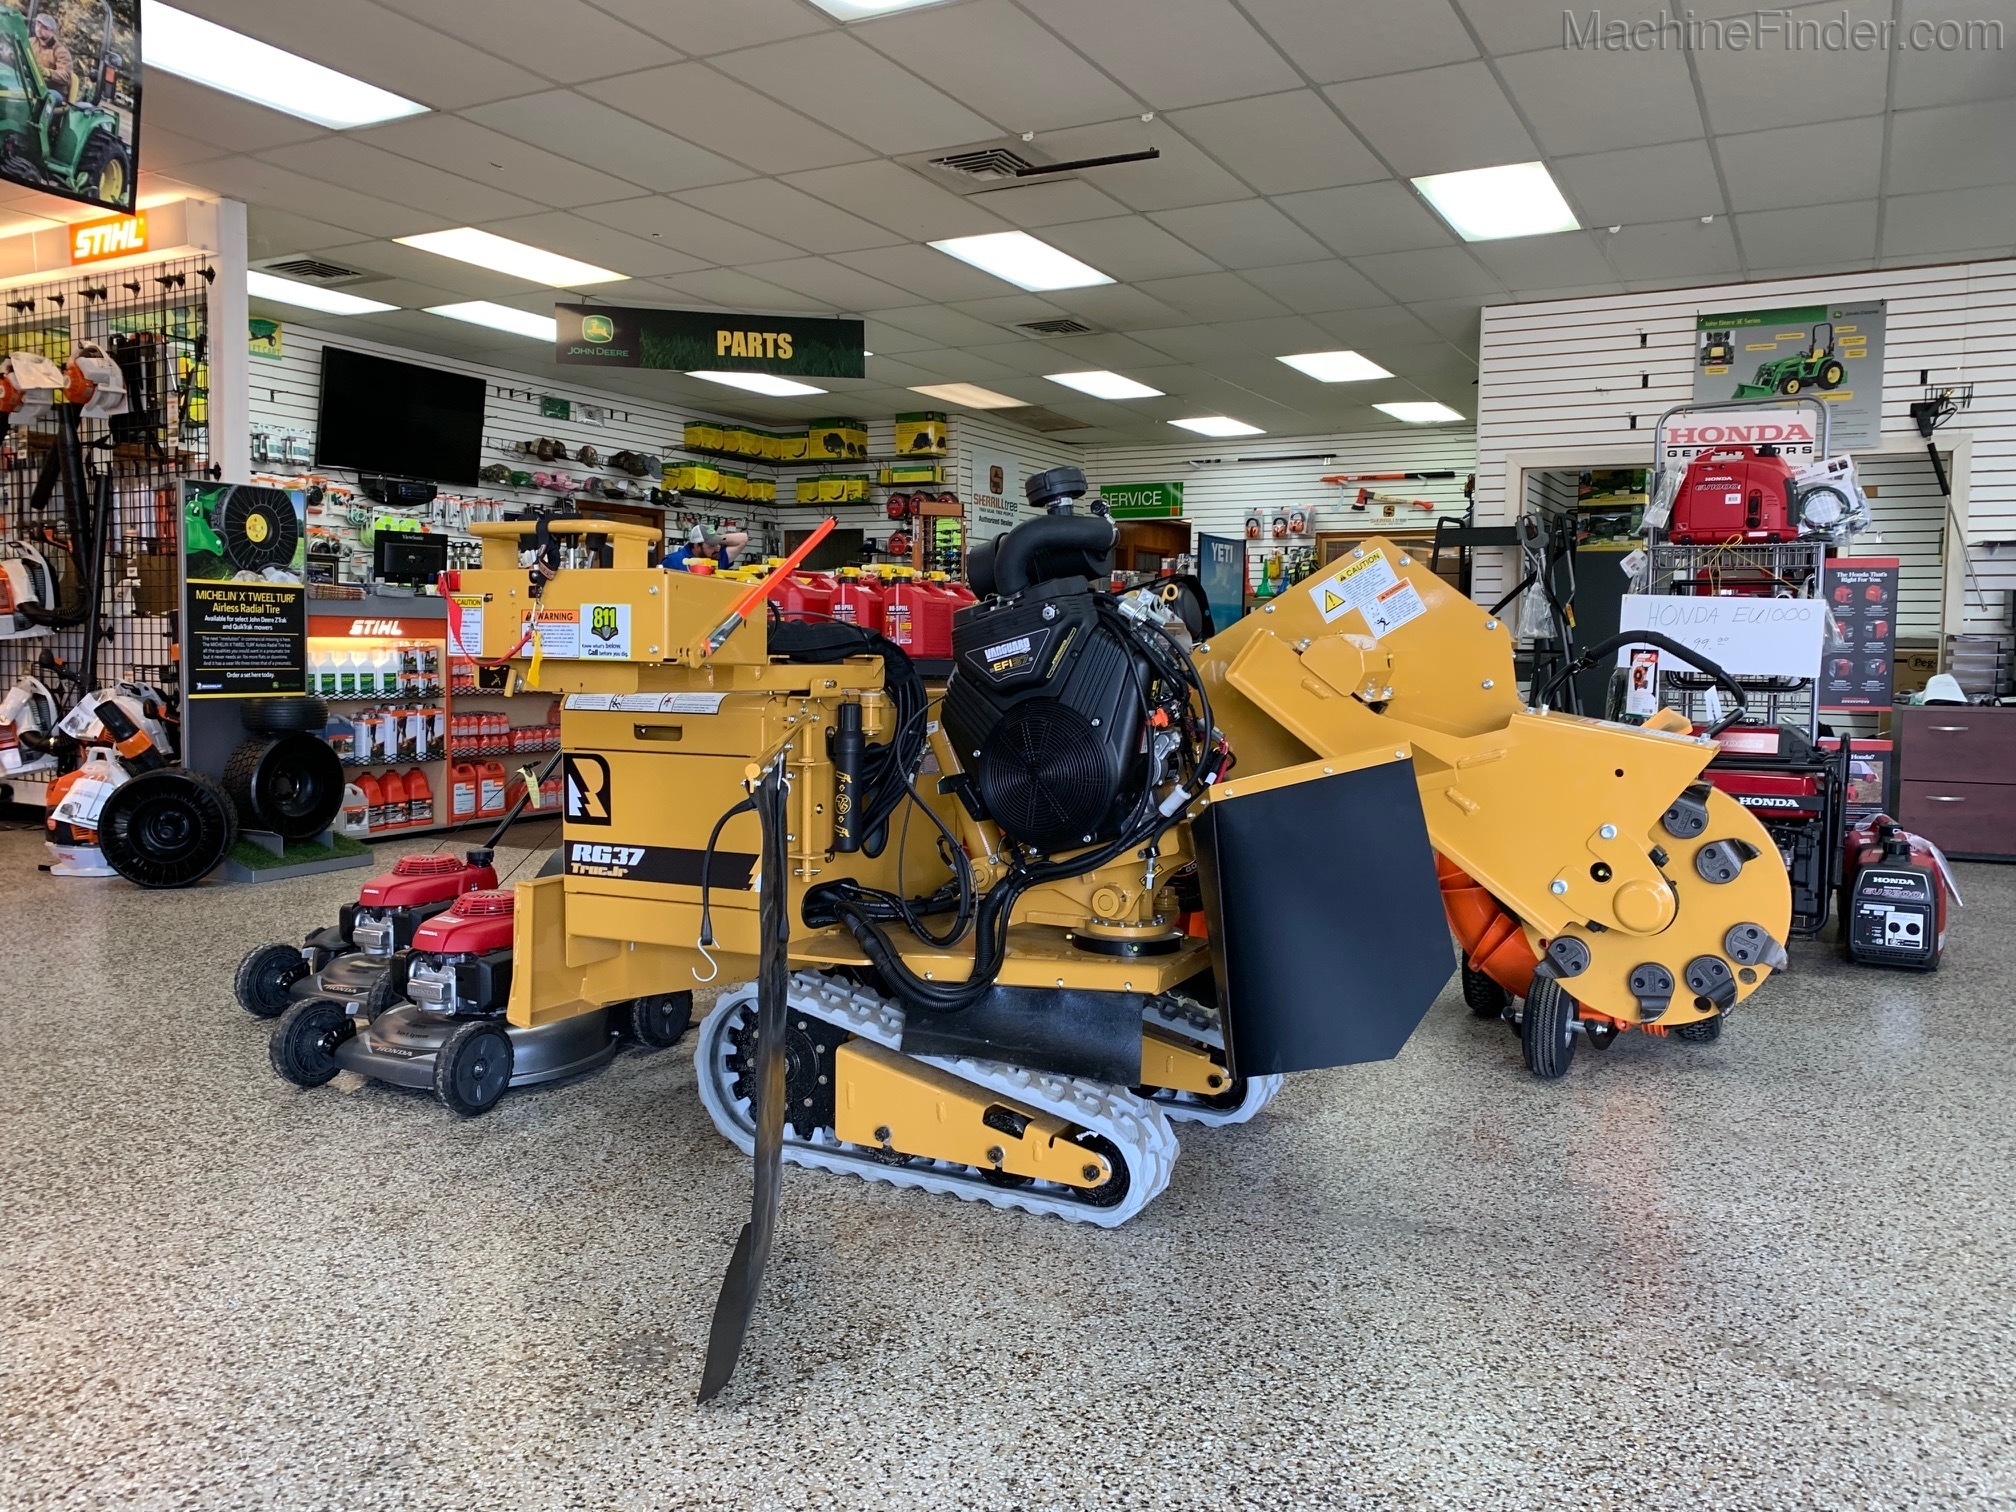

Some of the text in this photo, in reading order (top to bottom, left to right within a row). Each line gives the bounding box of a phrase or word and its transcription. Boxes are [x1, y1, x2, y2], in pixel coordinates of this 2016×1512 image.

[74, 218, 143, 258] STIHL
[1704, 320, 1718, 328] John
[1719, 319, 1735, 327] Deere
[1744, 317, 1762, 325] Series
[717, 330, 793, 359] PARTS
[567, 346, 629, 357] JOHN DEERE
[1667, 424, 1814, 444] HONDA
[1695, 483, 1741, 491] EU1000i
[1101, 491, 1162, 507] SERVICE
[979, 515, 1013, 527] Authorized Dealer
[402, 533, 424, 541] ViewSonic
[1211, 541, 1233, 563] YETI
[1346, 553, 1380, 577] CAUTION
[1385, 582, 1407, 596] WARNING
[196, 590, 296, 603] MICHELIN X TWEEL TURF
[457, 598, 481, 606] CAUTION
[212, 602, 280, 614] Airless Radial Tire
[537, 612, 574, 621] WARNING
[593, 606, 616, 628] 811
[1647, 602, 1720, 628] HONDA
[1732, 607, 1811, 624] EU1000
[349, 620, 402, 636] STIHL
[984, 637, 1030, 660] VANGUARD
[993, 658, 1013, 672] EFI
[1738, 796, 1800, 808] HONDA
[571, 844, 646, 866] RG37
[571, 862, 629, 878] TracJr
[1873, 876, 1916, 886] HONDA
[1862, 887, 1925, 899] EU2200i
[325, 985, 357, 994] HONDA
[408, 987, 438, 997] HONDA
[376, 1046, 413, 1056] HONDA
